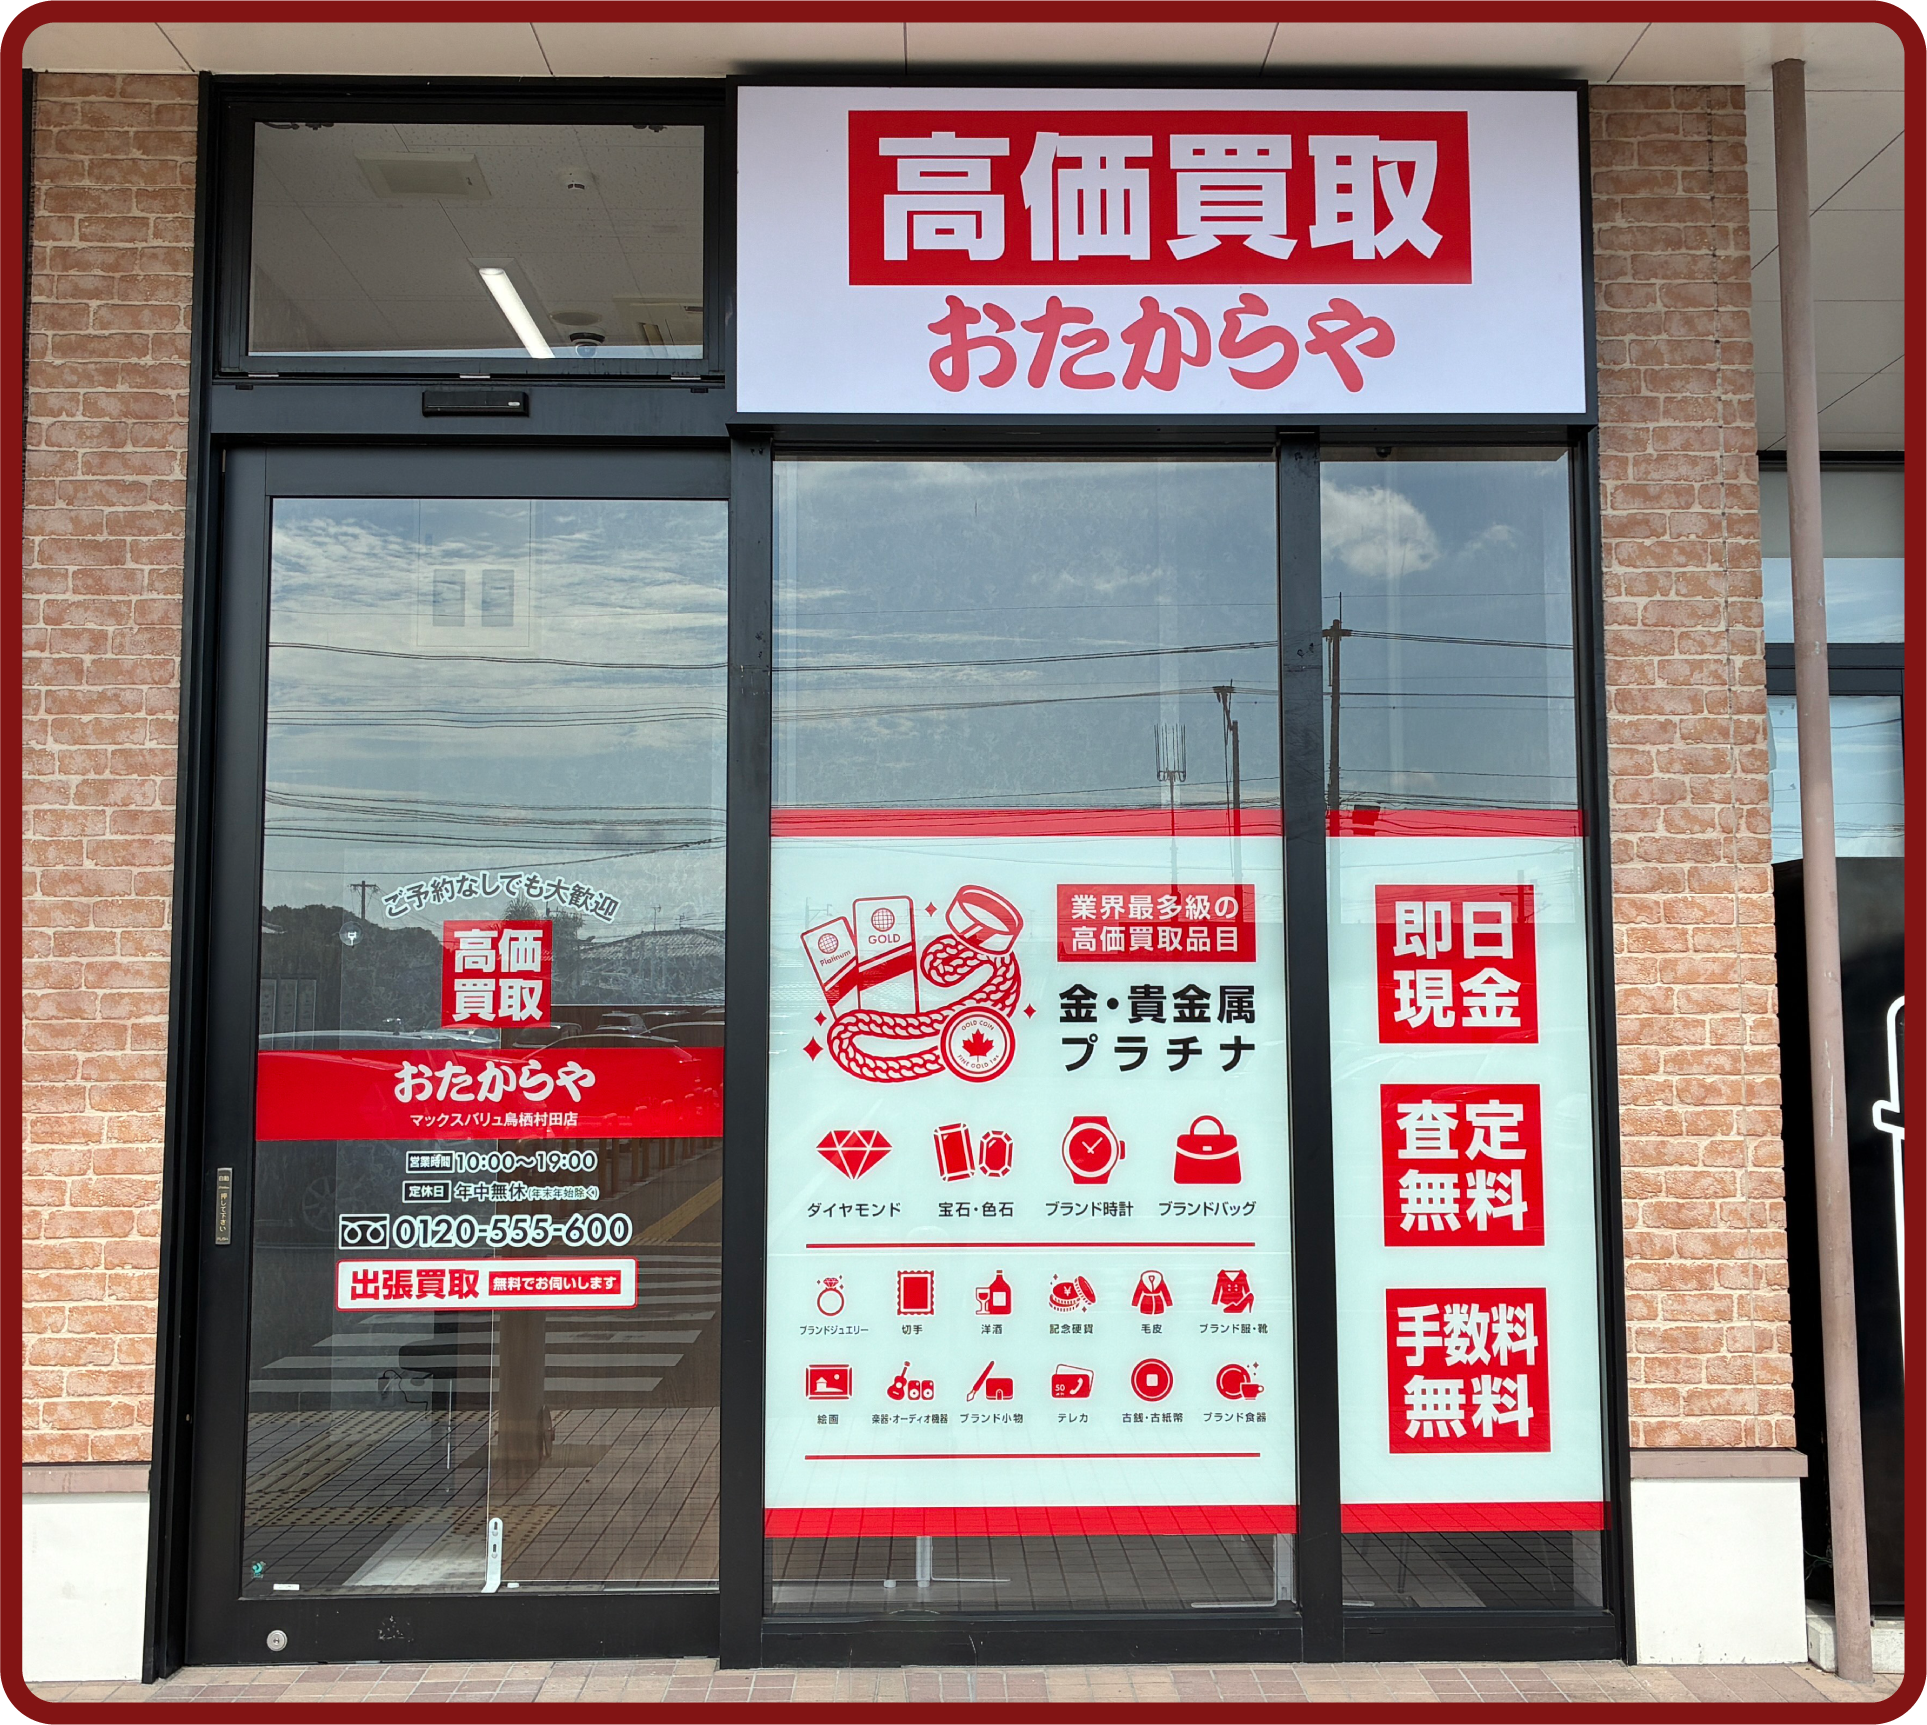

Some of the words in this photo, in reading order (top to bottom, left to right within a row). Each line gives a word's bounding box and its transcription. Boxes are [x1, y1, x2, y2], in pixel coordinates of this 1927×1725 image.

[878, 130, 1443, 261] 高価買取
[927, 292, 1396, 393] おたからや
[382, 871, 622, 924] ご予約なしでも大歓迎
[1071, 894, 1239, 920] 業界最多級の
[868, 933, 901, 945] GOLD
[1071, 926, 1239, 952] 高価買取品目
[1394, 901, 1515, 960] 即日
[453, 928, 544, 973] 高価
[819, 950, 852, 967] Platinum
[452, 978, 543, 1021] 買取
[1059, 983, 1256, 1024] 金・貴金属
[1394, 967, 1522, 1029] 現金
[1061, 1033, 1256, 1072] プラチナ
[394, 1059, 596, 1103] おたからや
[410, 1111, 579, 1128] マックスバリュ鳥栖村田店
[1396, 1099, 1527, 1160] 査定
[409, 1155, 451, 1169] 営業時間
[408, 1185, 445, 1198] 定休日
[1045, 1201, 1134, 1217] ブランド時計
[1158, 1201, 1257, 1217] ブランドバッグ
[1398, 1168, 1529, 1233] 無料
[807, 1202, 901, 1218] ダイヤモンド
[938, 1201, 1015, 1218] 宝石・色石
[392, 1212, 634, 1249] 0120-555-600
[350, 1269, 480, 1301] 出張買取
[492, 1276, 617, 1291] 無料でお伺いします
[799, 1325, 869, 1336] ブランドジュエリー
[901, 1324, 923, 1335] 切手
[981, 1324, 1003, 1335] 洋酒
[1049, 1323, 1094, 1335] 記念硬貨
[1141, 1323, 1163, 1334] 毛皮
[1396, 1302, 1539, 1368] 手数料
[1055, 1384, 1065, 1392] 50
[1404, 1372, 1535, 1438] 無料
[817, 1413, 839, 1425] 絵画
[960, 1413, 1024, 1424] ブランド小物
[1057, 1413, 1089, 1423] テレカ
[1203, 1411, 1267, 1423] ブランド食器
